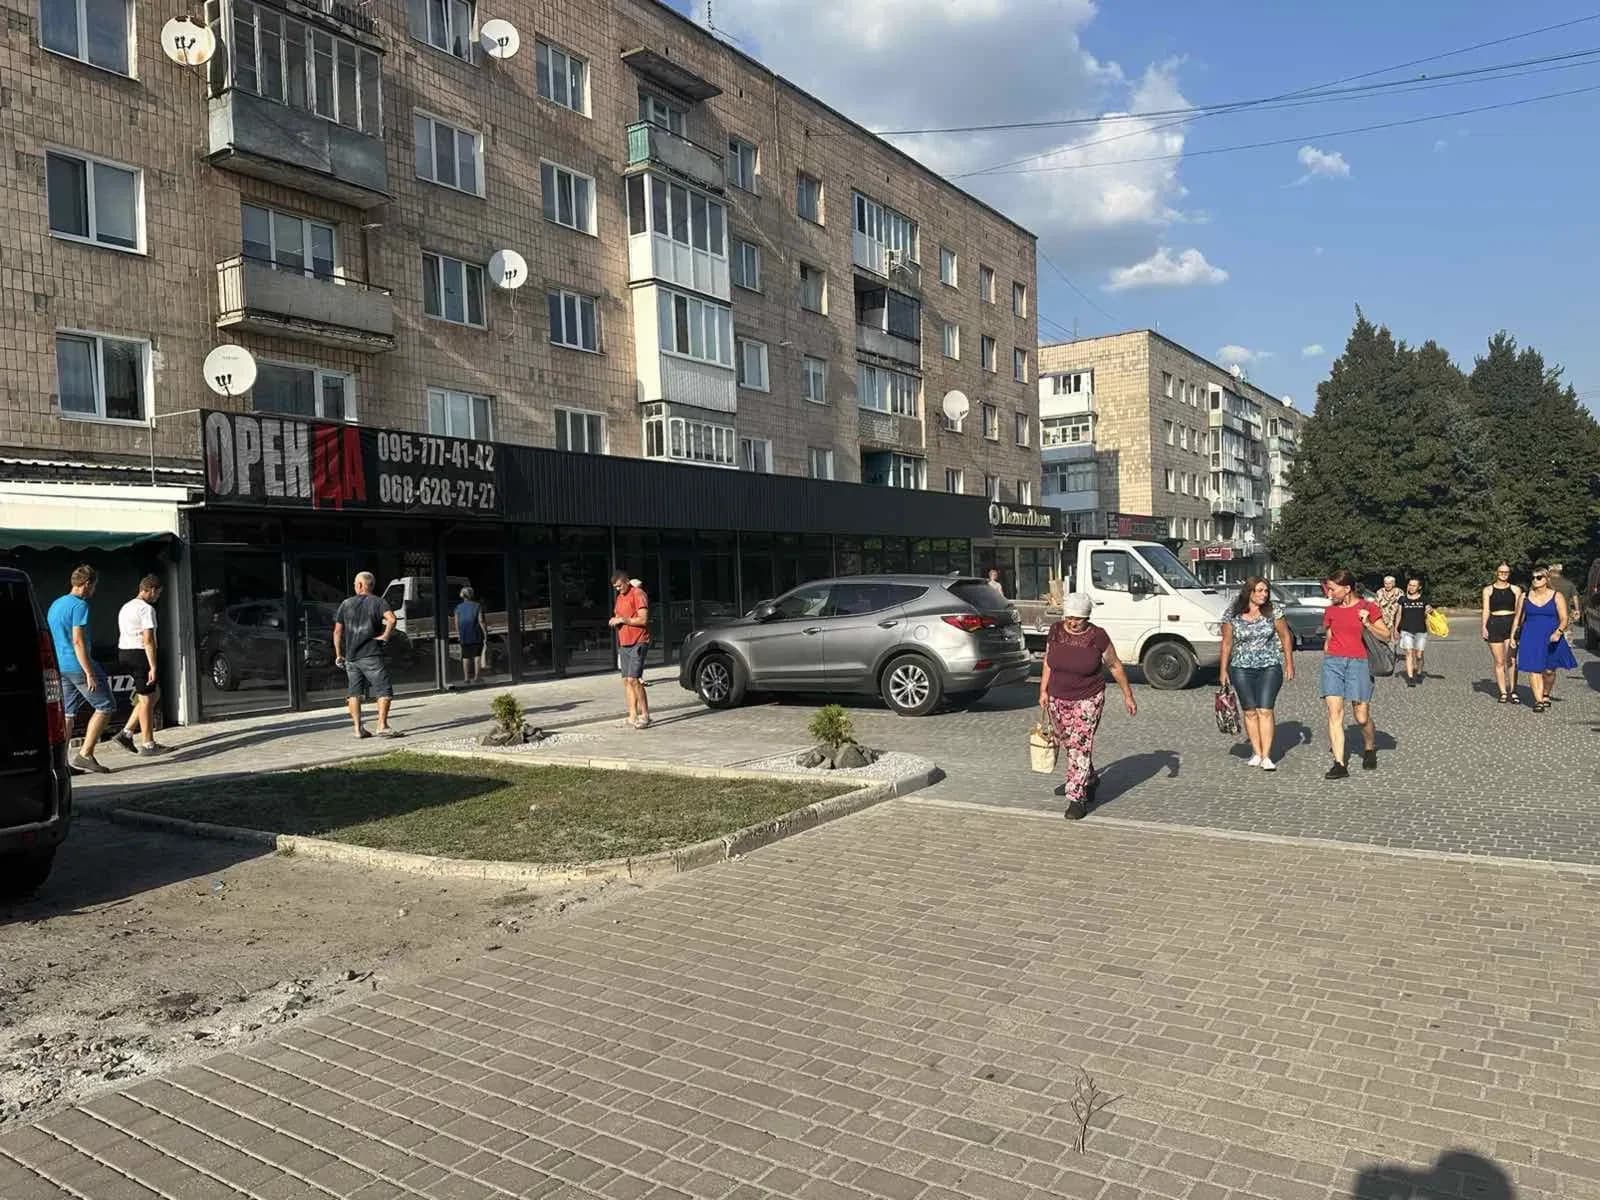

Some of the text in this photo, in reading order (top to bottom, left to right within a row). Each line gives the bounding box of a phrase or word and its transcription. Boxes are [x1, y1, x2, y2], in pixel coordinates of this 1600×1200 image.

[205, 411, 366, 511] ОРЕНДА
[377, 431, 495, 472] 095-777-41-42
[379, 473, 495, 509] 068-628-27-27
